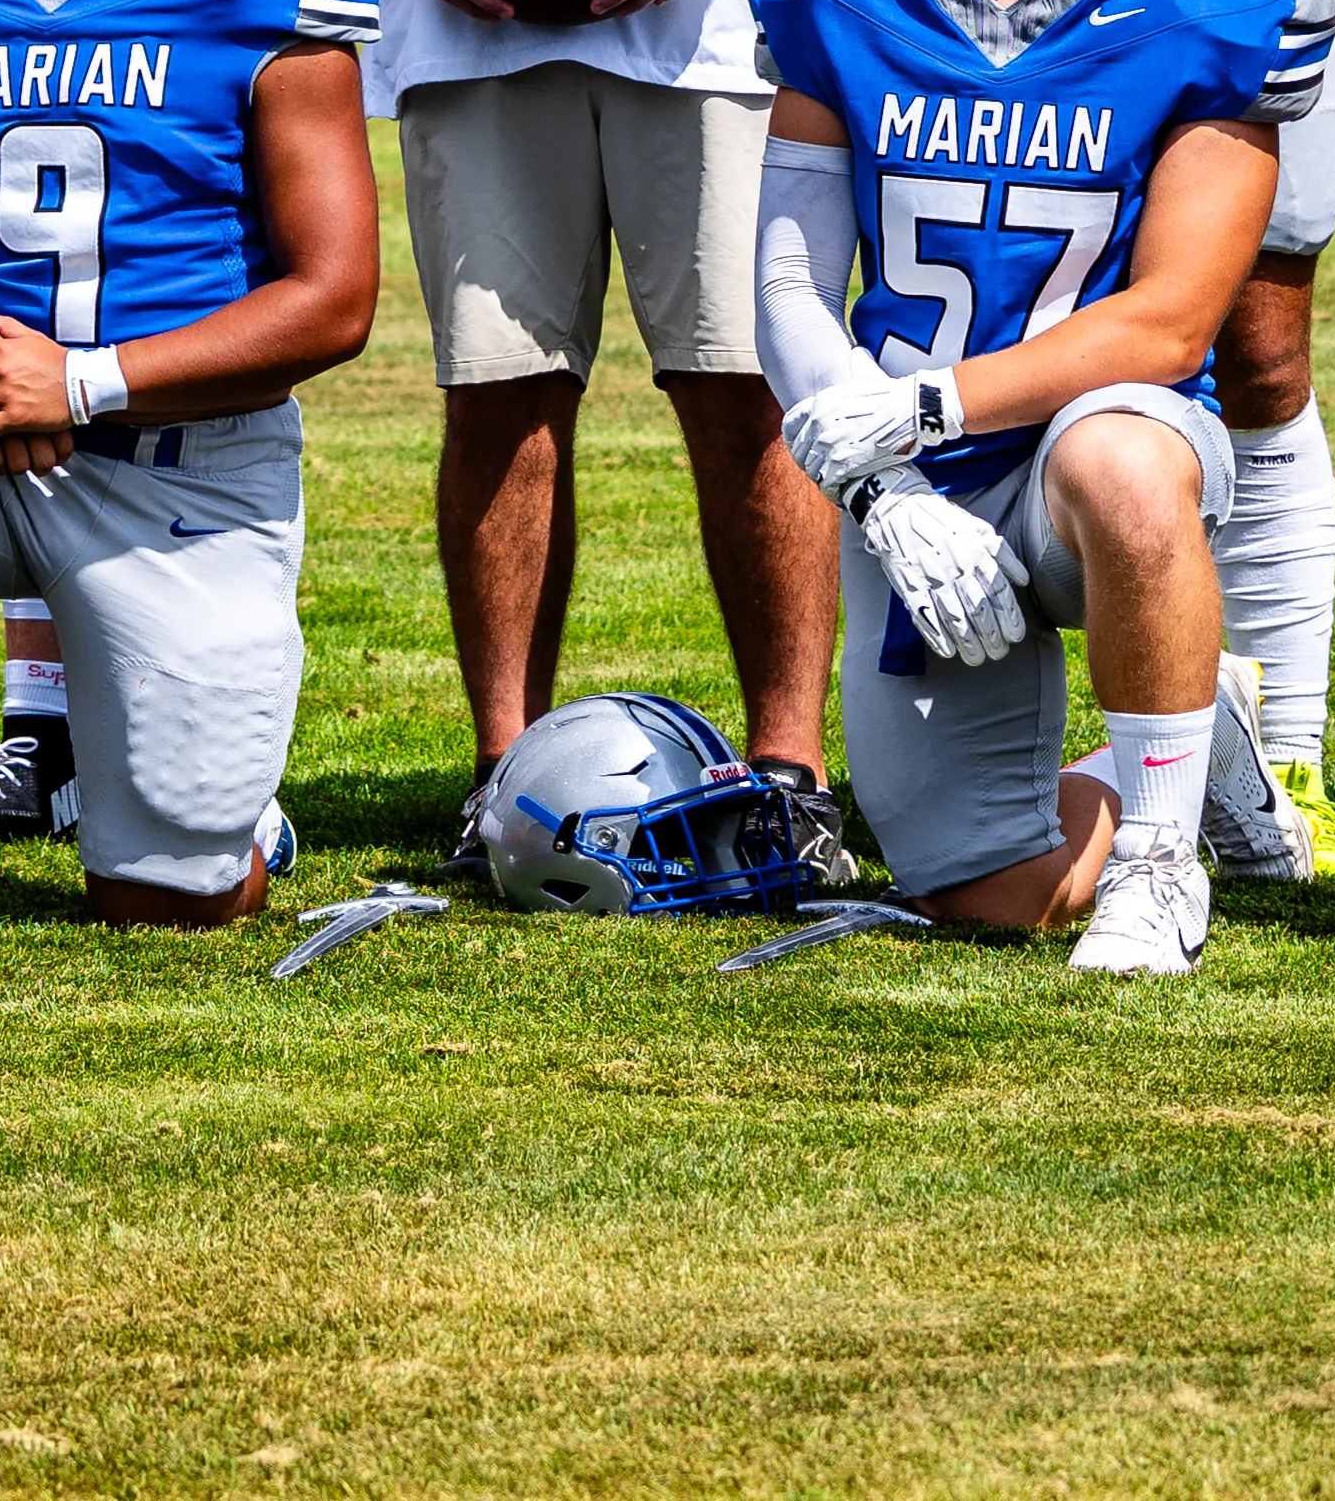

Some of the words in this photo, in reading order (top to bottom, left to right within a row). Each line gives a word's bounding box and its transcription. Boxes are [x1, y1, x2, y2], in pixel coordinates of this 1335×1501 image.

[875, 91, 1113, 173] MARIAN
[876, 173, 1121, 375] 57
[918, 382, 946, 436] NIKE
